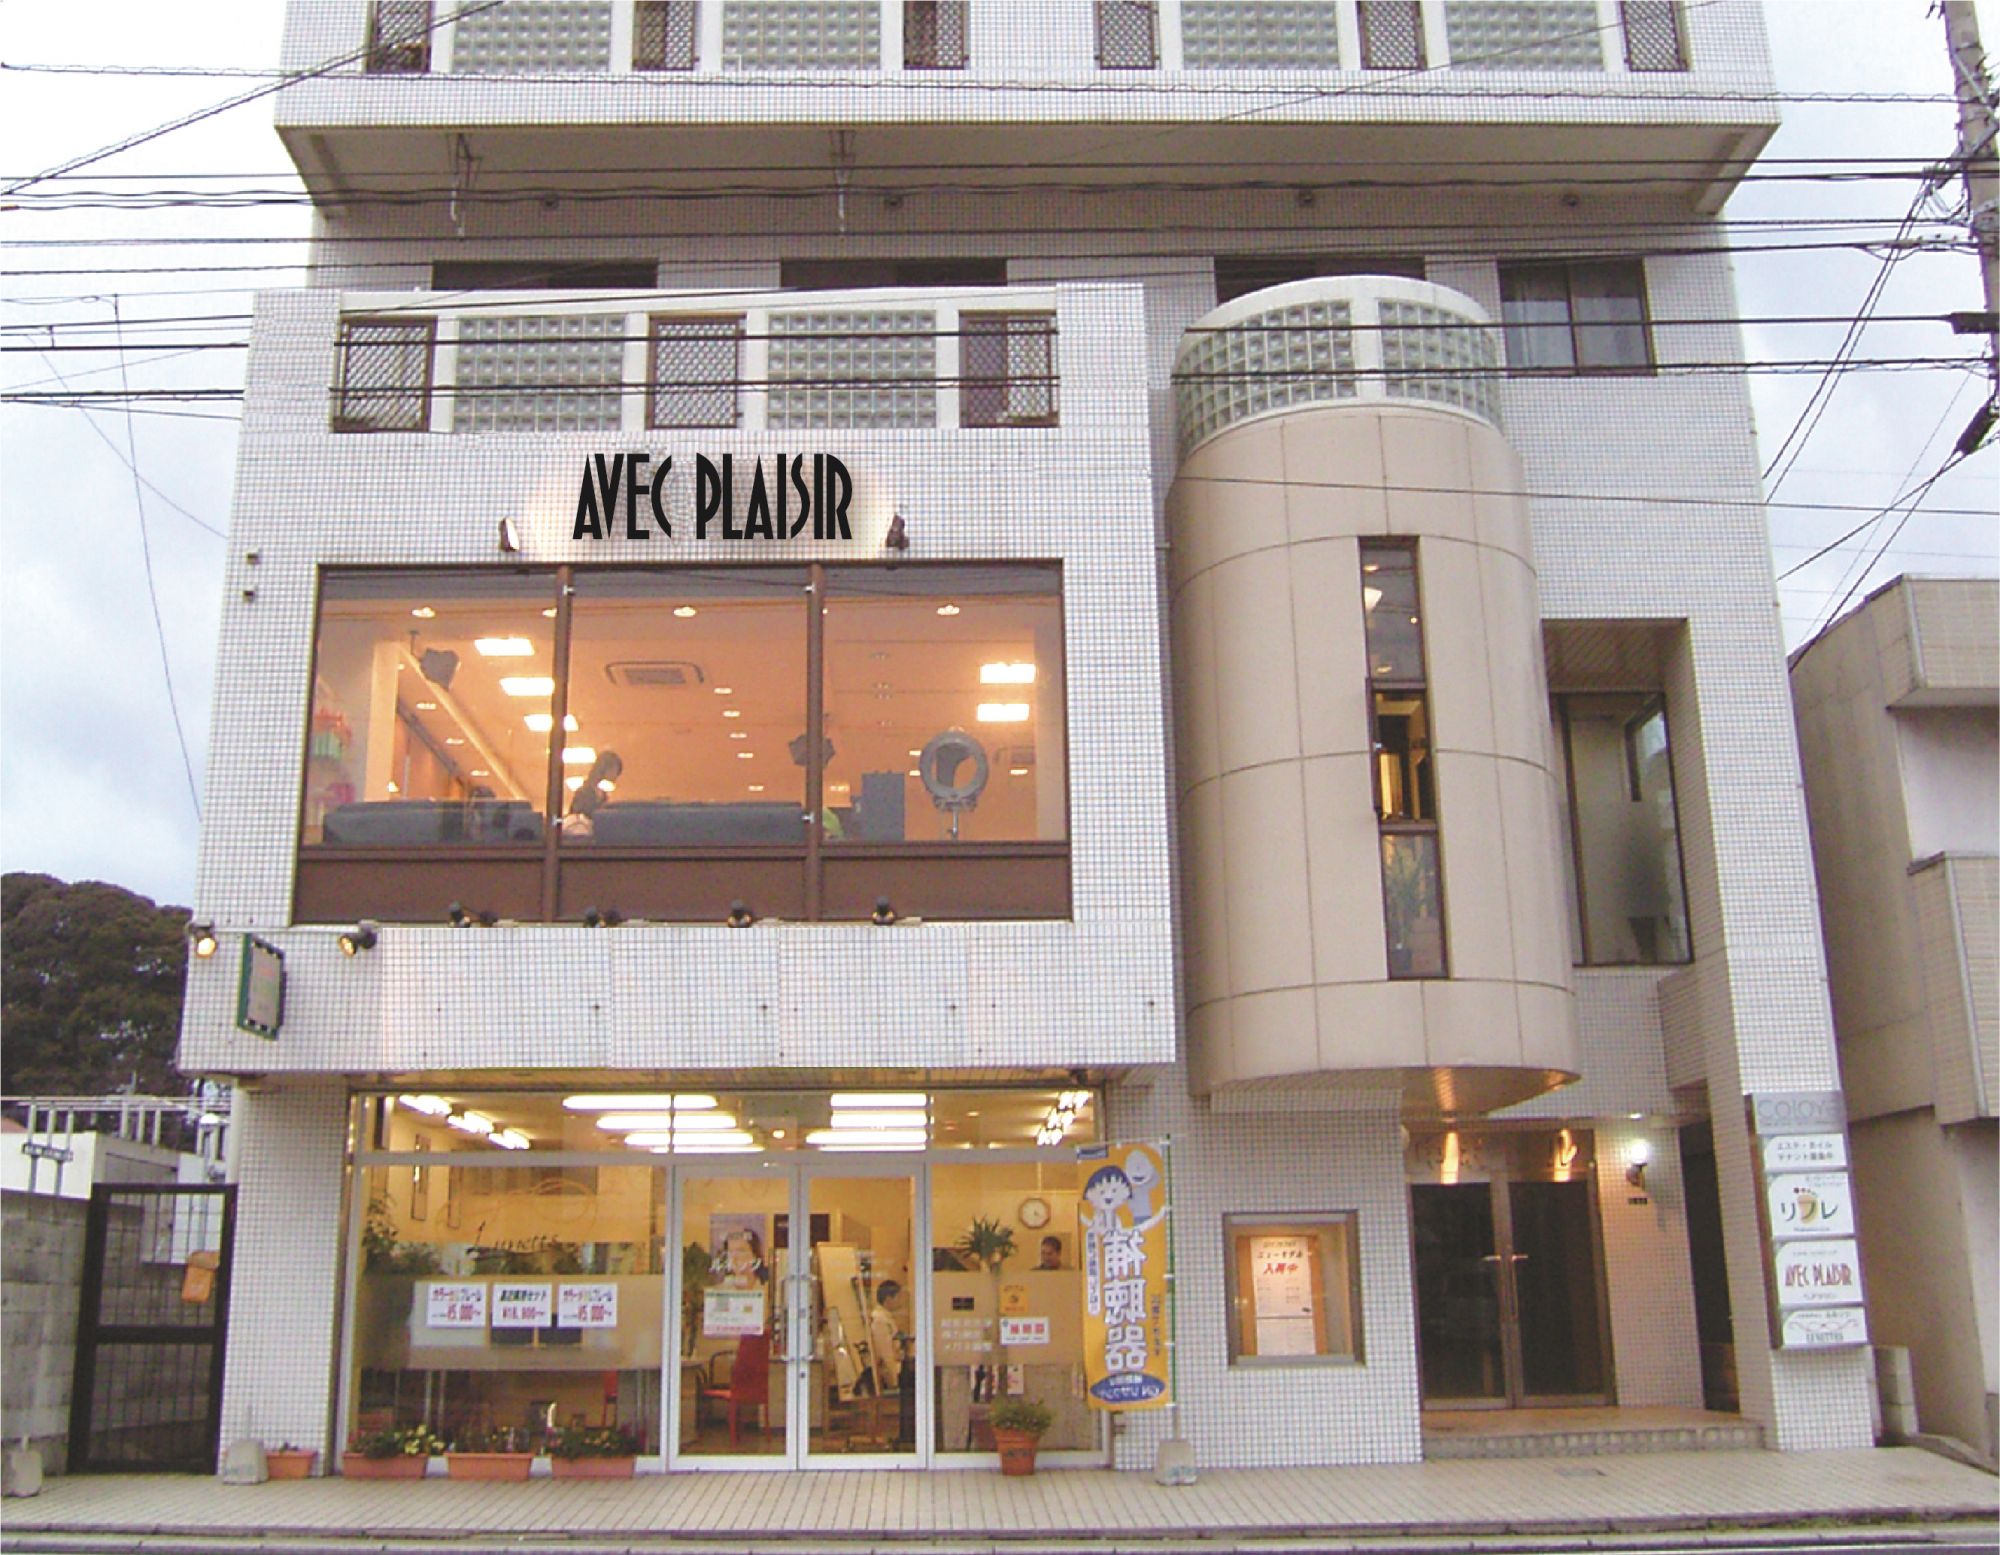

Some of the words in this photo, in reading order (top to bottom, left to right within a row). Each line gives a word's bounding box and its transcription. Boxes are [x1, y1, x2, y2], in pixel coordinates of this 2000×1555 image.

[572, 453, 672, 540] AVEC
[696, 452, 853, 540] PLAISIR
[1780, 1200, 1839, 1222] リフレ
[1785, 1263, 1810, 1288] AVEC
[1812, 1262, 1852, 1287] PLAISIR
